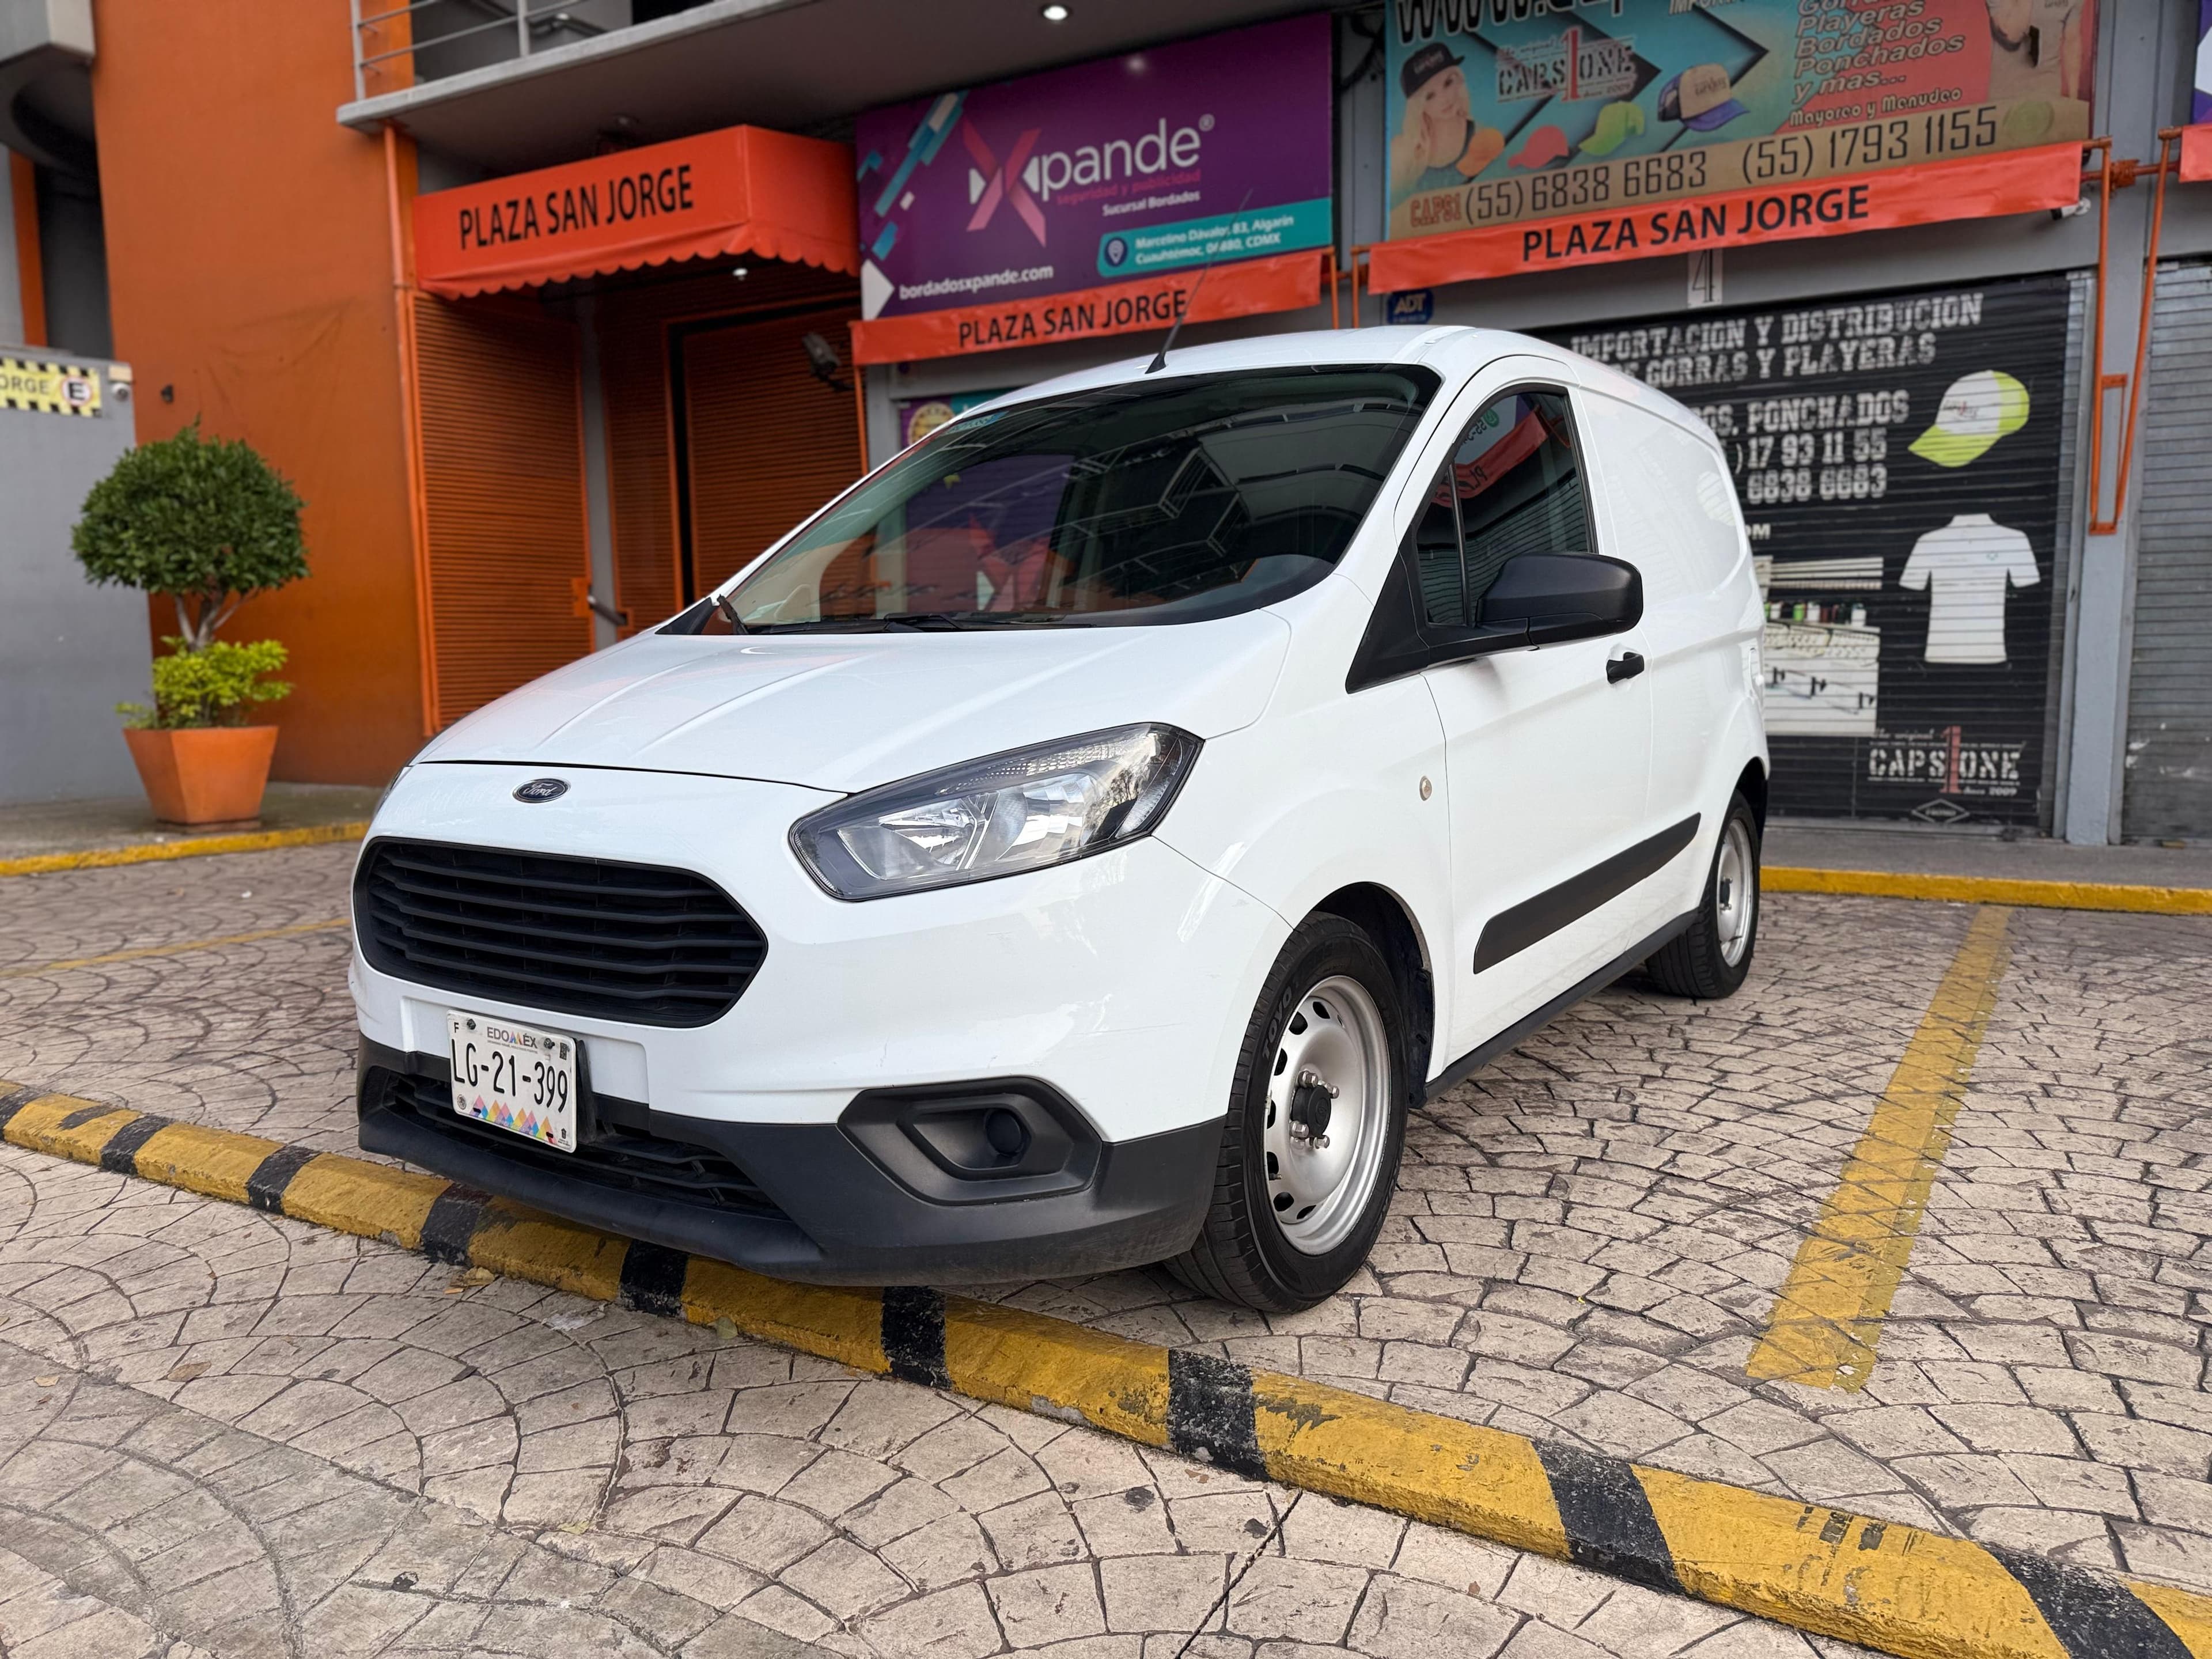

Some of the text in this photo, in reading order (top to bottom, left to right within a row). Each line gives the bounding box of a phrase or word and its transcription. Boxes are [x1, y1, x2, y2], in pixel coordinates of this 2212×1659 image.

[1797, 0, 1924, 36] Playeras
[1794, 35, 1964, 78] Ponchados
[1796, 19, 1942, 57] Bordados
[1793, 71, 1906, 104] y mas...
[1790, 88, 1961, 127] Mayoreo y Menudeo
[1466, 181, 1524, 225] (55)
[1532, 166, 1609, 211] 6838
[1624, 151, 1706, 197] 6683
[1743, 135, 1813, 184] (55)
[1830, 120, 1908, 168] 1793
[1926, 106, 1997, 154] 1155
[459, 164, 694, 249] PLAZA SAN JORGE
[1102, 191, 1200, 216] Sucursal Bordados
[1135, 232, 1187, 249] Marcelino
[1245, 232, 1281, 248] CDMX
[1523, 185, 1869, 262] PLAZA SAN JORGE
[899, 266, 1054, 300] bordadosxpande.com
[1692, 247, 1715, 303] 4
[959, 290, 1187, 347] PLAZA SAN JORGE
[1395, 293, 1426, 314] ADT
[1571, 293, 1983, 362] IMPORTACION Y DISTRIBUCION
[1646, 351, 1748, 388] GORRAS
[1756, 348, 1775, 378] Y
[1783, 332, 1936, 376] PLAYERAS
[68, 381, 86, 402] E
[1747, 389, 1910, 434] PONCHADOS
[1781, 433, 1815, 467] 93
[1822, 431, 1845, 464] 11
[1853, 427, 1887, 462] 55
[522, 782, 558, 796] Ford
[1989, 786, 2017, 796] 2009
[453, 1021, 460, 1033] F
[1262, 986, 1292, 1060] TOYO
[451, 1038, 569, 1113] LG-21-399
